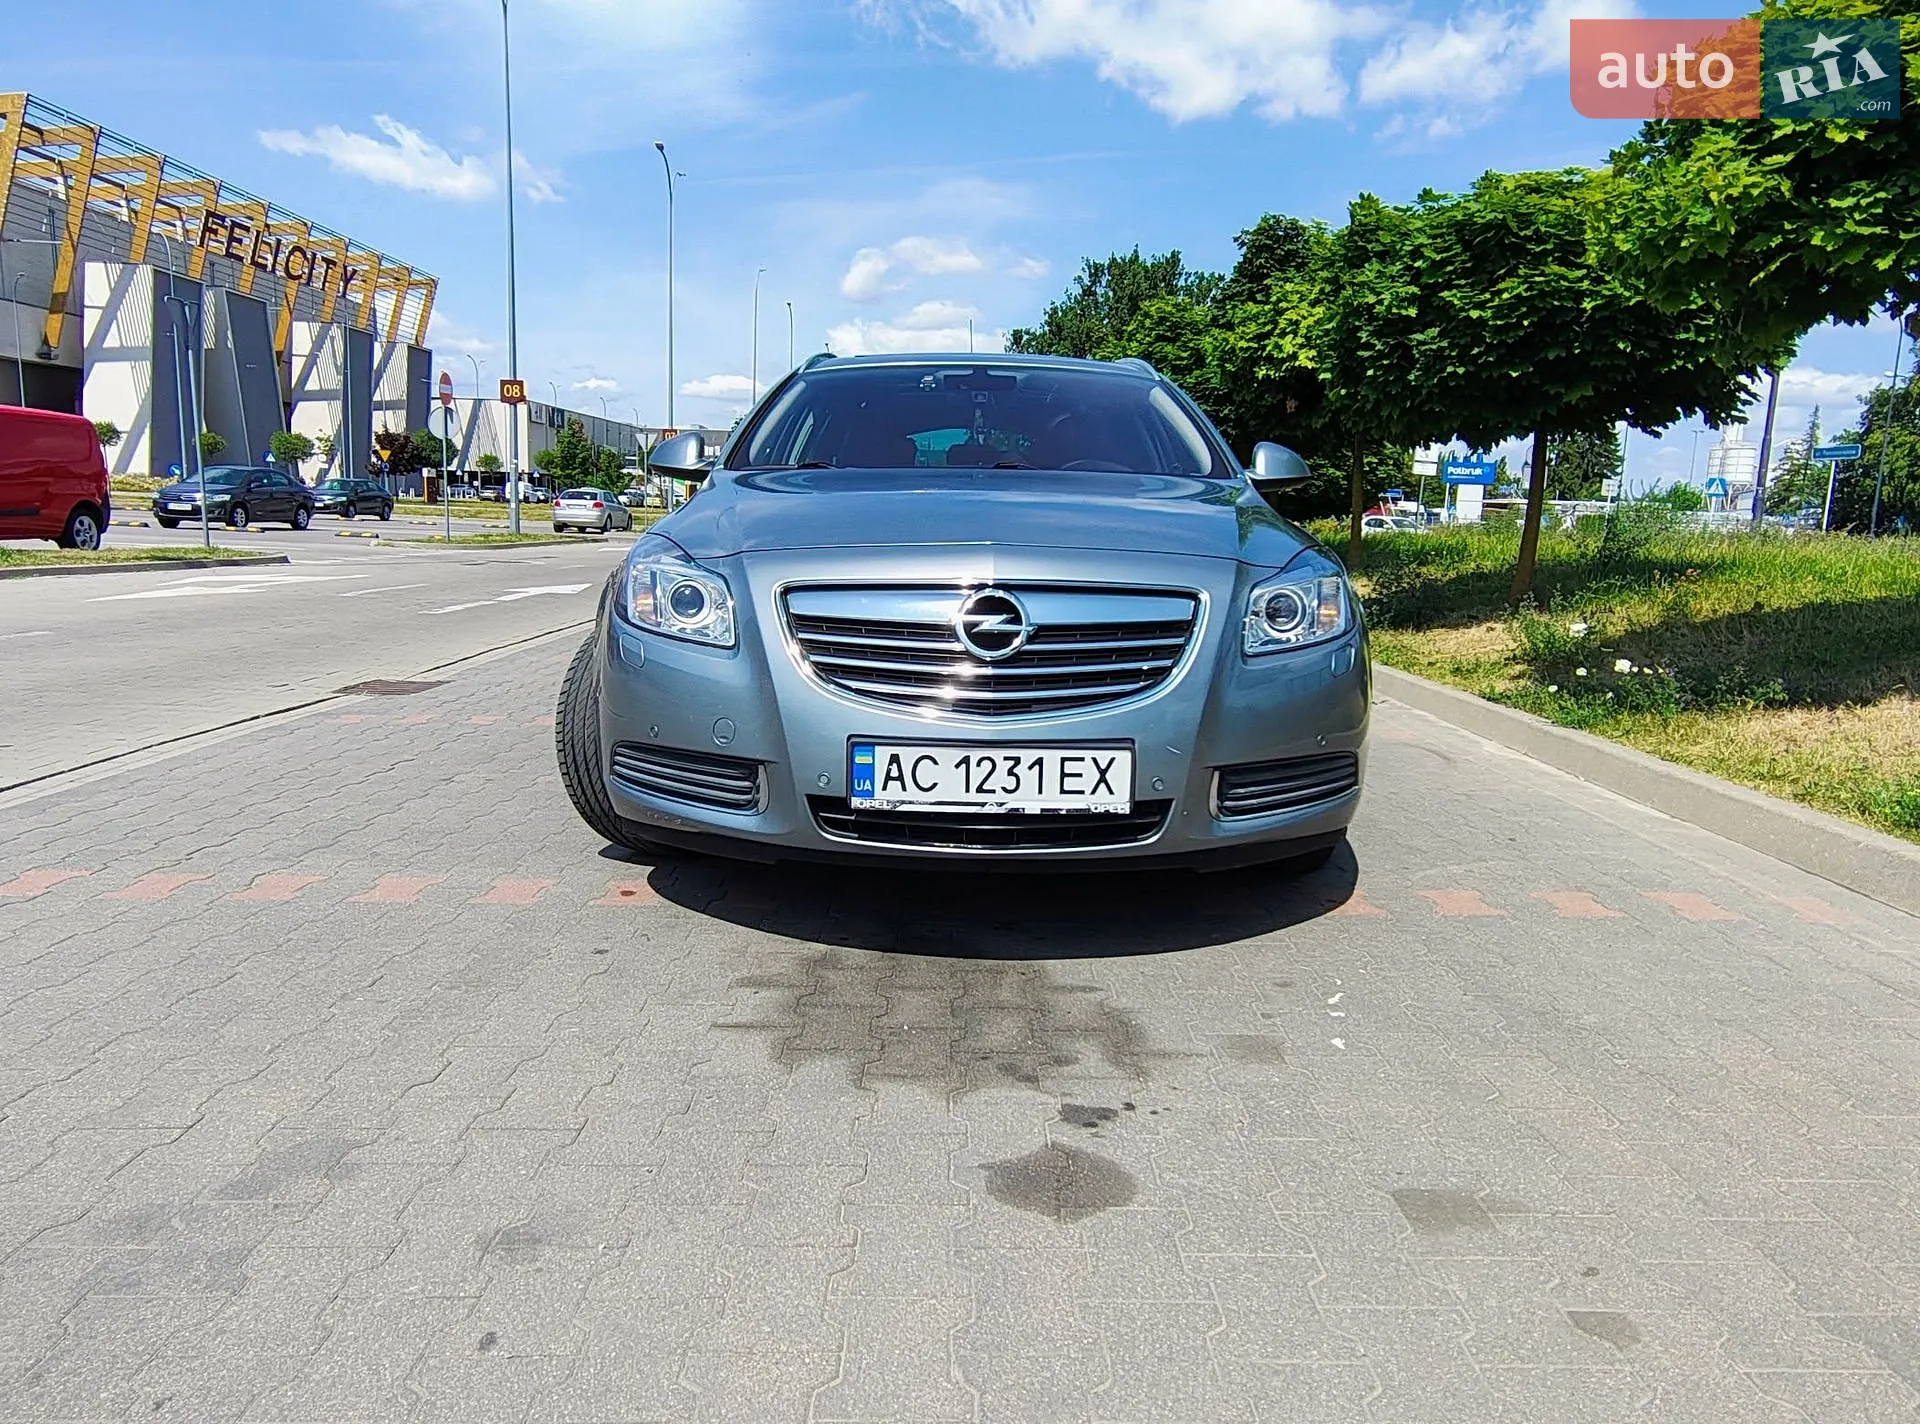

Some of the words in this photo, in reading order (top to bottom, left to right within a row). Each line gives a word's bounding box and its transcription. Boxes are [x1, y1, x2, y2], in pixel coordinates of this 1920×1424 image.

[198, 209, 358, 298] FELICITY
[503, 384, 521, 398] 08
[1447, 466, 1483, 476] Polbruk
[881, 753, 940, 793] AC
[954, 754, 1044, 795] 1231
[1059, 756, 1116, 796] EX
[854, 779, 872, 792] UA
[856, 798, 891, 809] OPEL
[1090, 802, 1126, 814] OPEL
